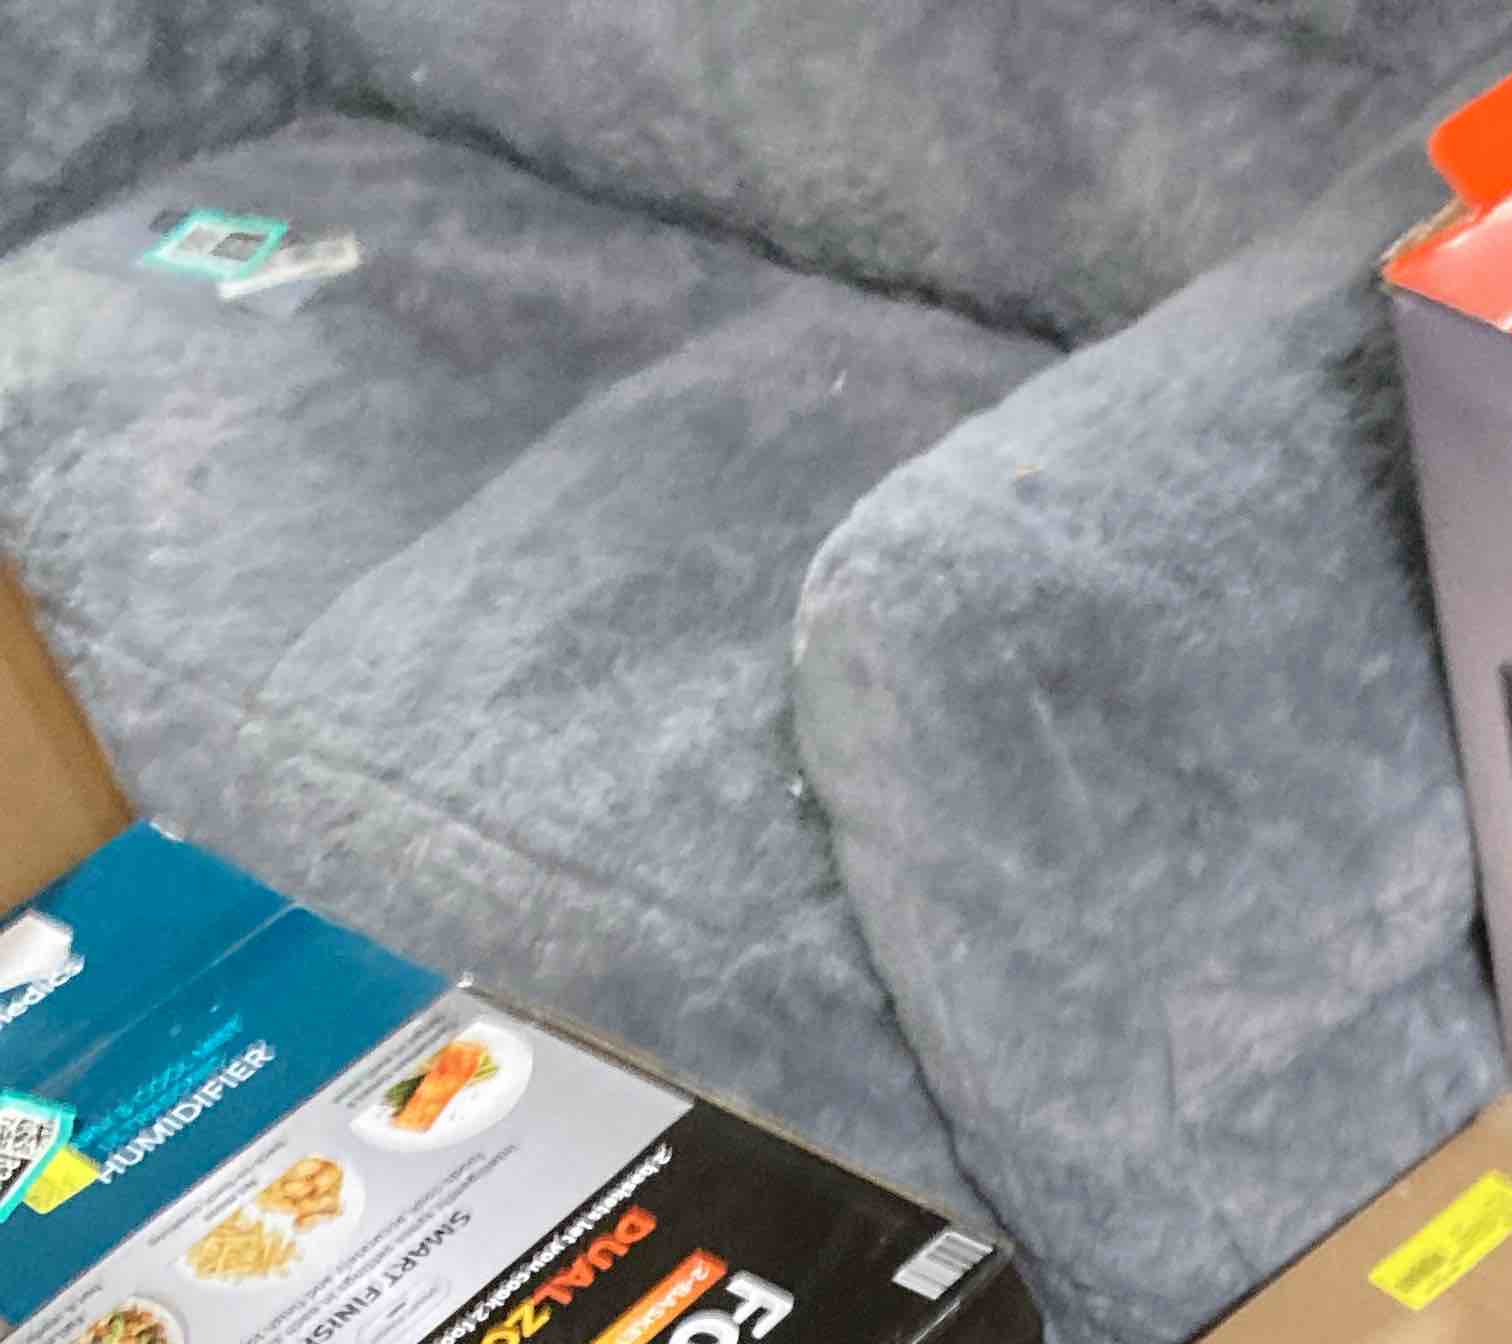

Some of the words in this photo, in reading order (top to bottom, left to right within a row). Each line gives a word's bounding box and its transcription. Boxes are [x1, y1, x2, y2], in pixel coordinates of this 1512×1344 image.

[98, 1038, 277, 1184] HUMIDIFIER
[382, 1209, 471, 1293] SMART
[524, 1234, 567, 1275] you
[482, 1266, 533, 1313] cook
